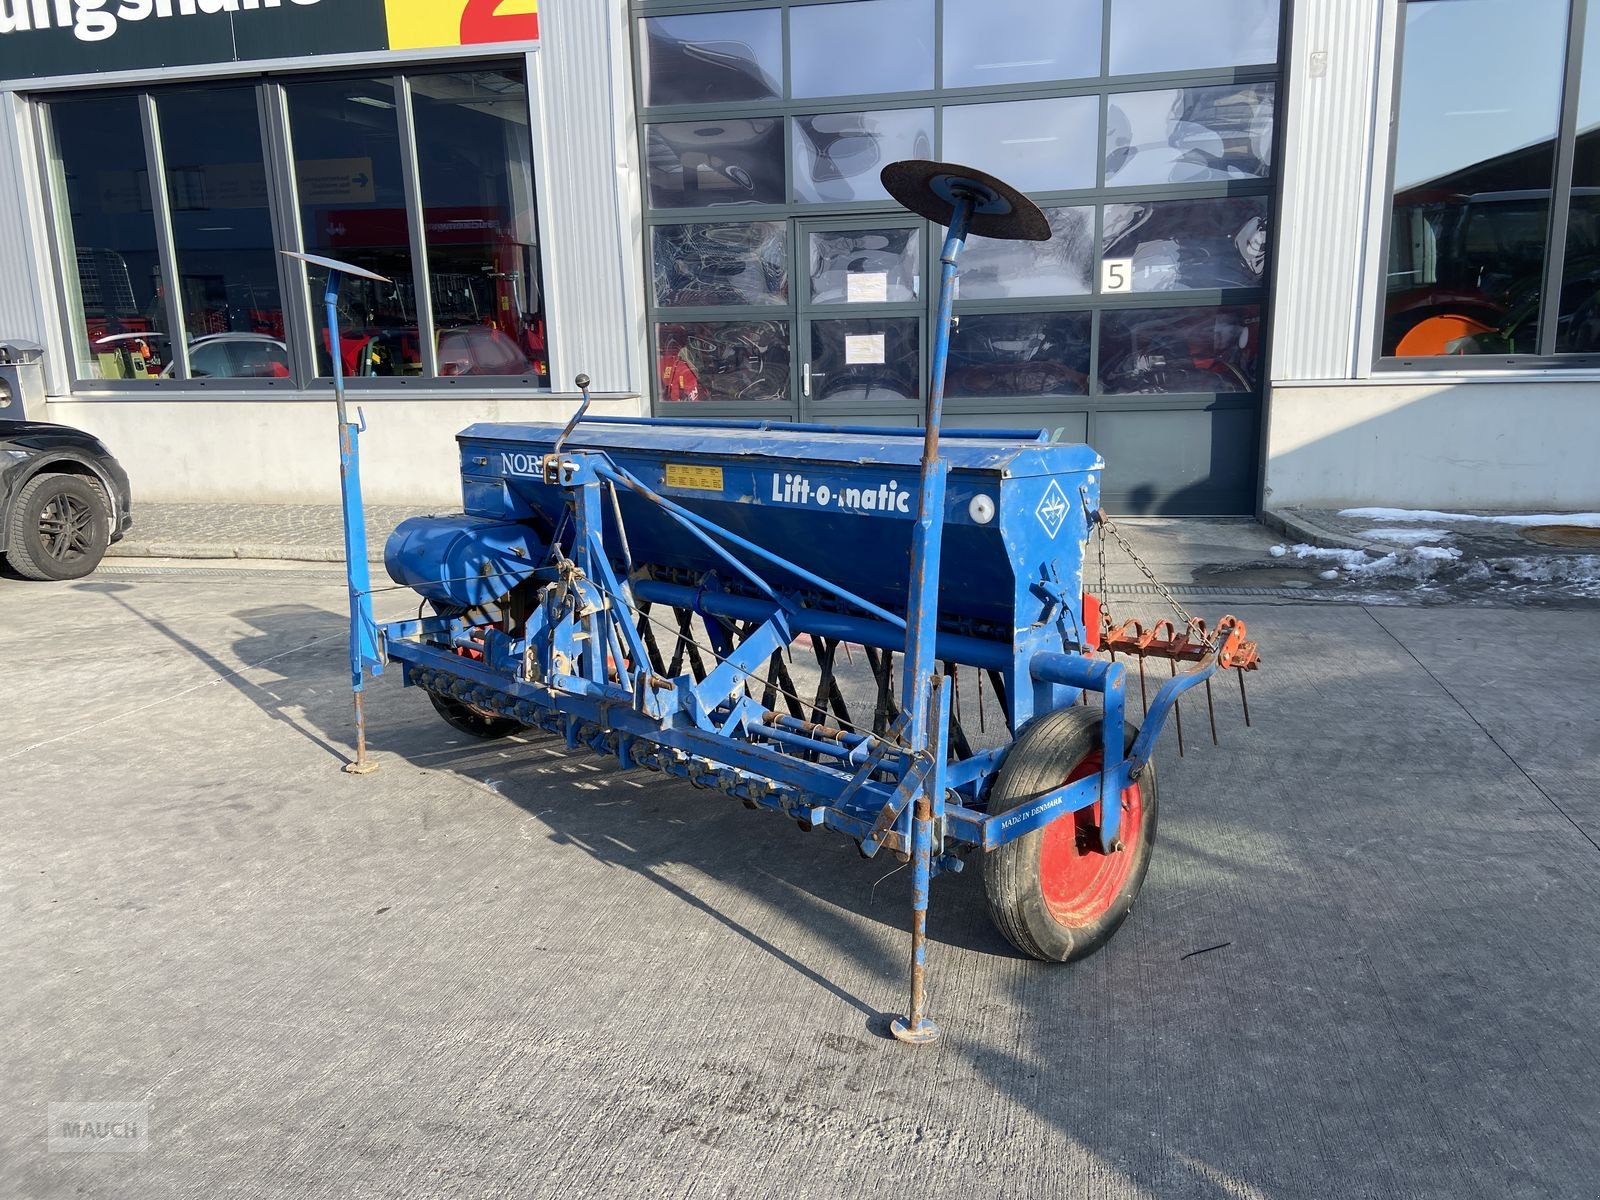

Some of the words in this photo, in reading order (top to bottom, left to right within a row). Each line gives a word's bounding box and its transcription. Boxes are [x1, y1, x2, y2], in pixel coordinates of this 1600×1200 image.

[1108, 263, 1124, 289] 5
[501, 452, 544, 478] NOR
[772, 472, 910, 513] Lift-o-matic
[1001, 815, 1021, 829] MADE
[1022, 811, 1030, 820] IN
[1031, 796, 1063, 816] DENMARK
